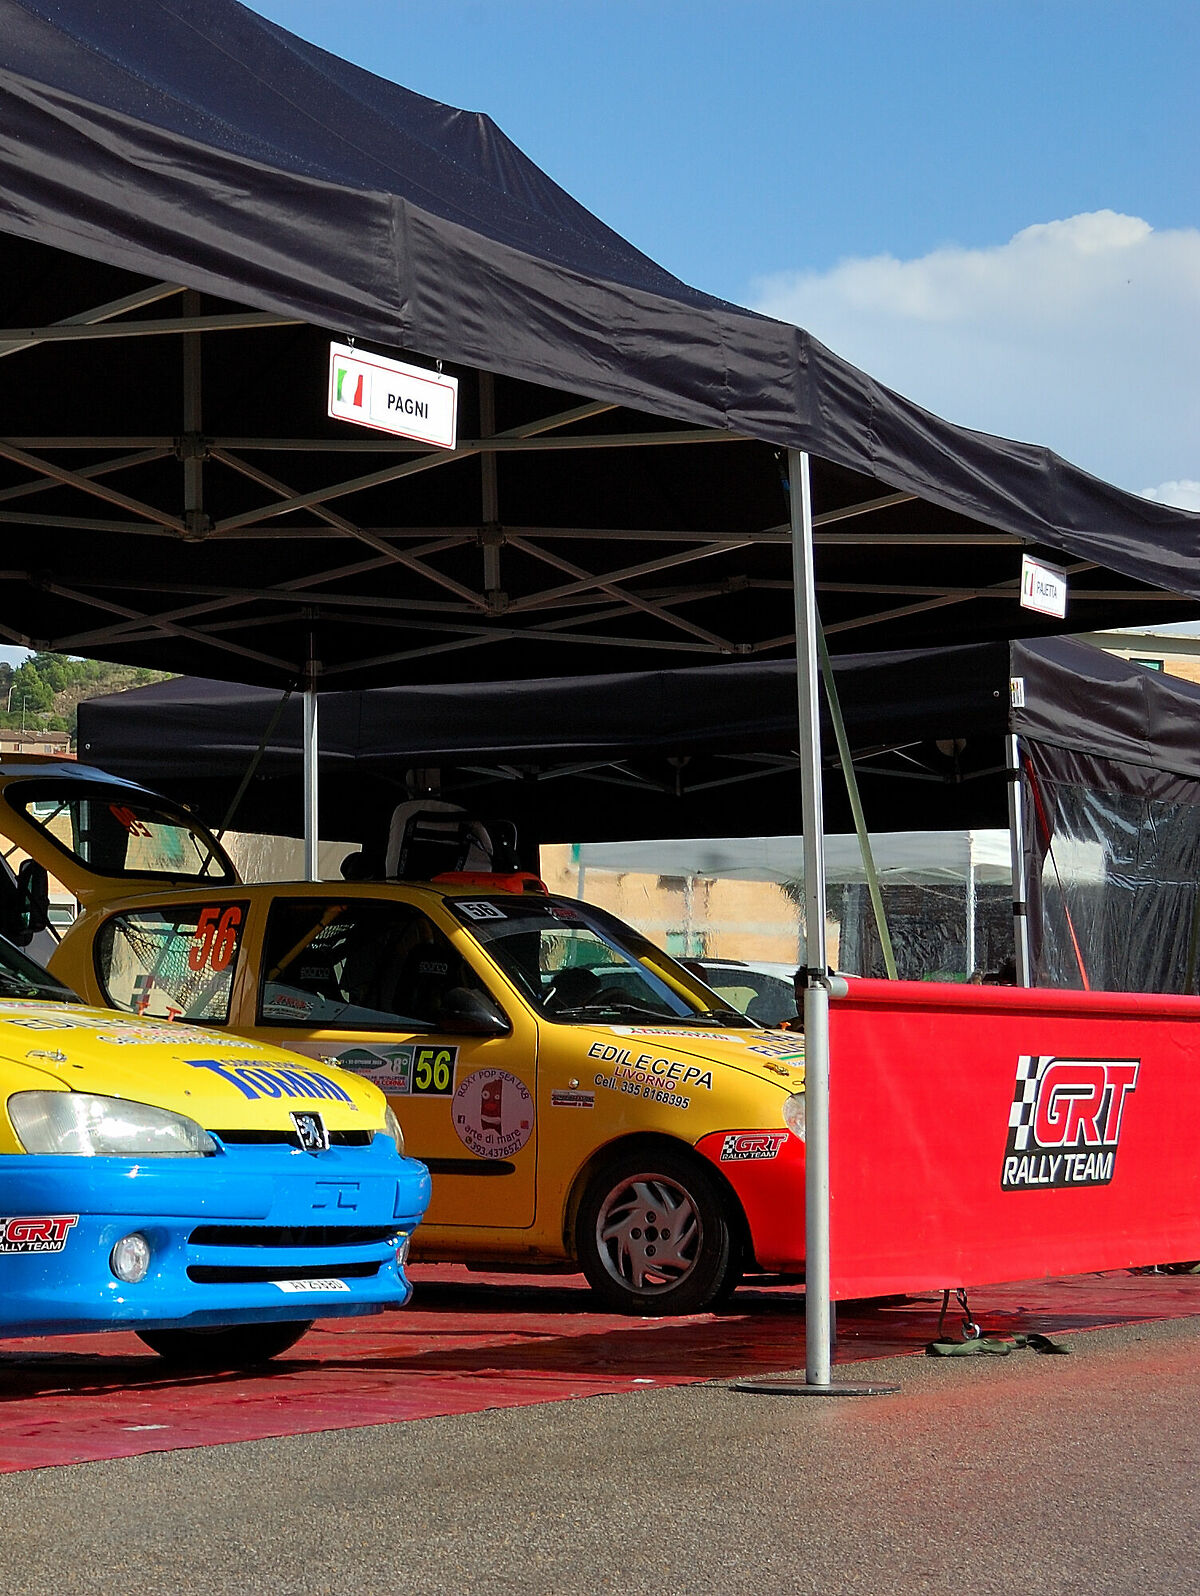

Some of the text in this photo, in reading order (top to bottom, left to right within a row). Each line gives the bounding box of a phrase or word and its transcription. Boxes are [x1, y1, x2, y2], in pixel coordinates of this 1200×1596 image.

[387, 392, 428, 419] PAGNI
[462, 902, 499, 917] 56
[188, 906, 242, 972] 56
[415, 1050, 451, 1091] 56
[587, 1042, 713, 1090] EDILECEPA
[614, 1066, 676, 1091] LIVORNO
[457, 1070, 530, 1101] ROXY POP SEA LAB
[594, 1074, 690, 1109] Cell. 335 8168395
[1034, 1061, 1140, 1147] GRT
[465, 1124, 522, 1144] arte di mare
[735, 1135, 786, 1152] GRT
[1002, 1151, 1114, 1185] RALLY TEAM
[7, 1217, 76, 1242] GRT
[26, 1241, 62, 1251] TEAM
